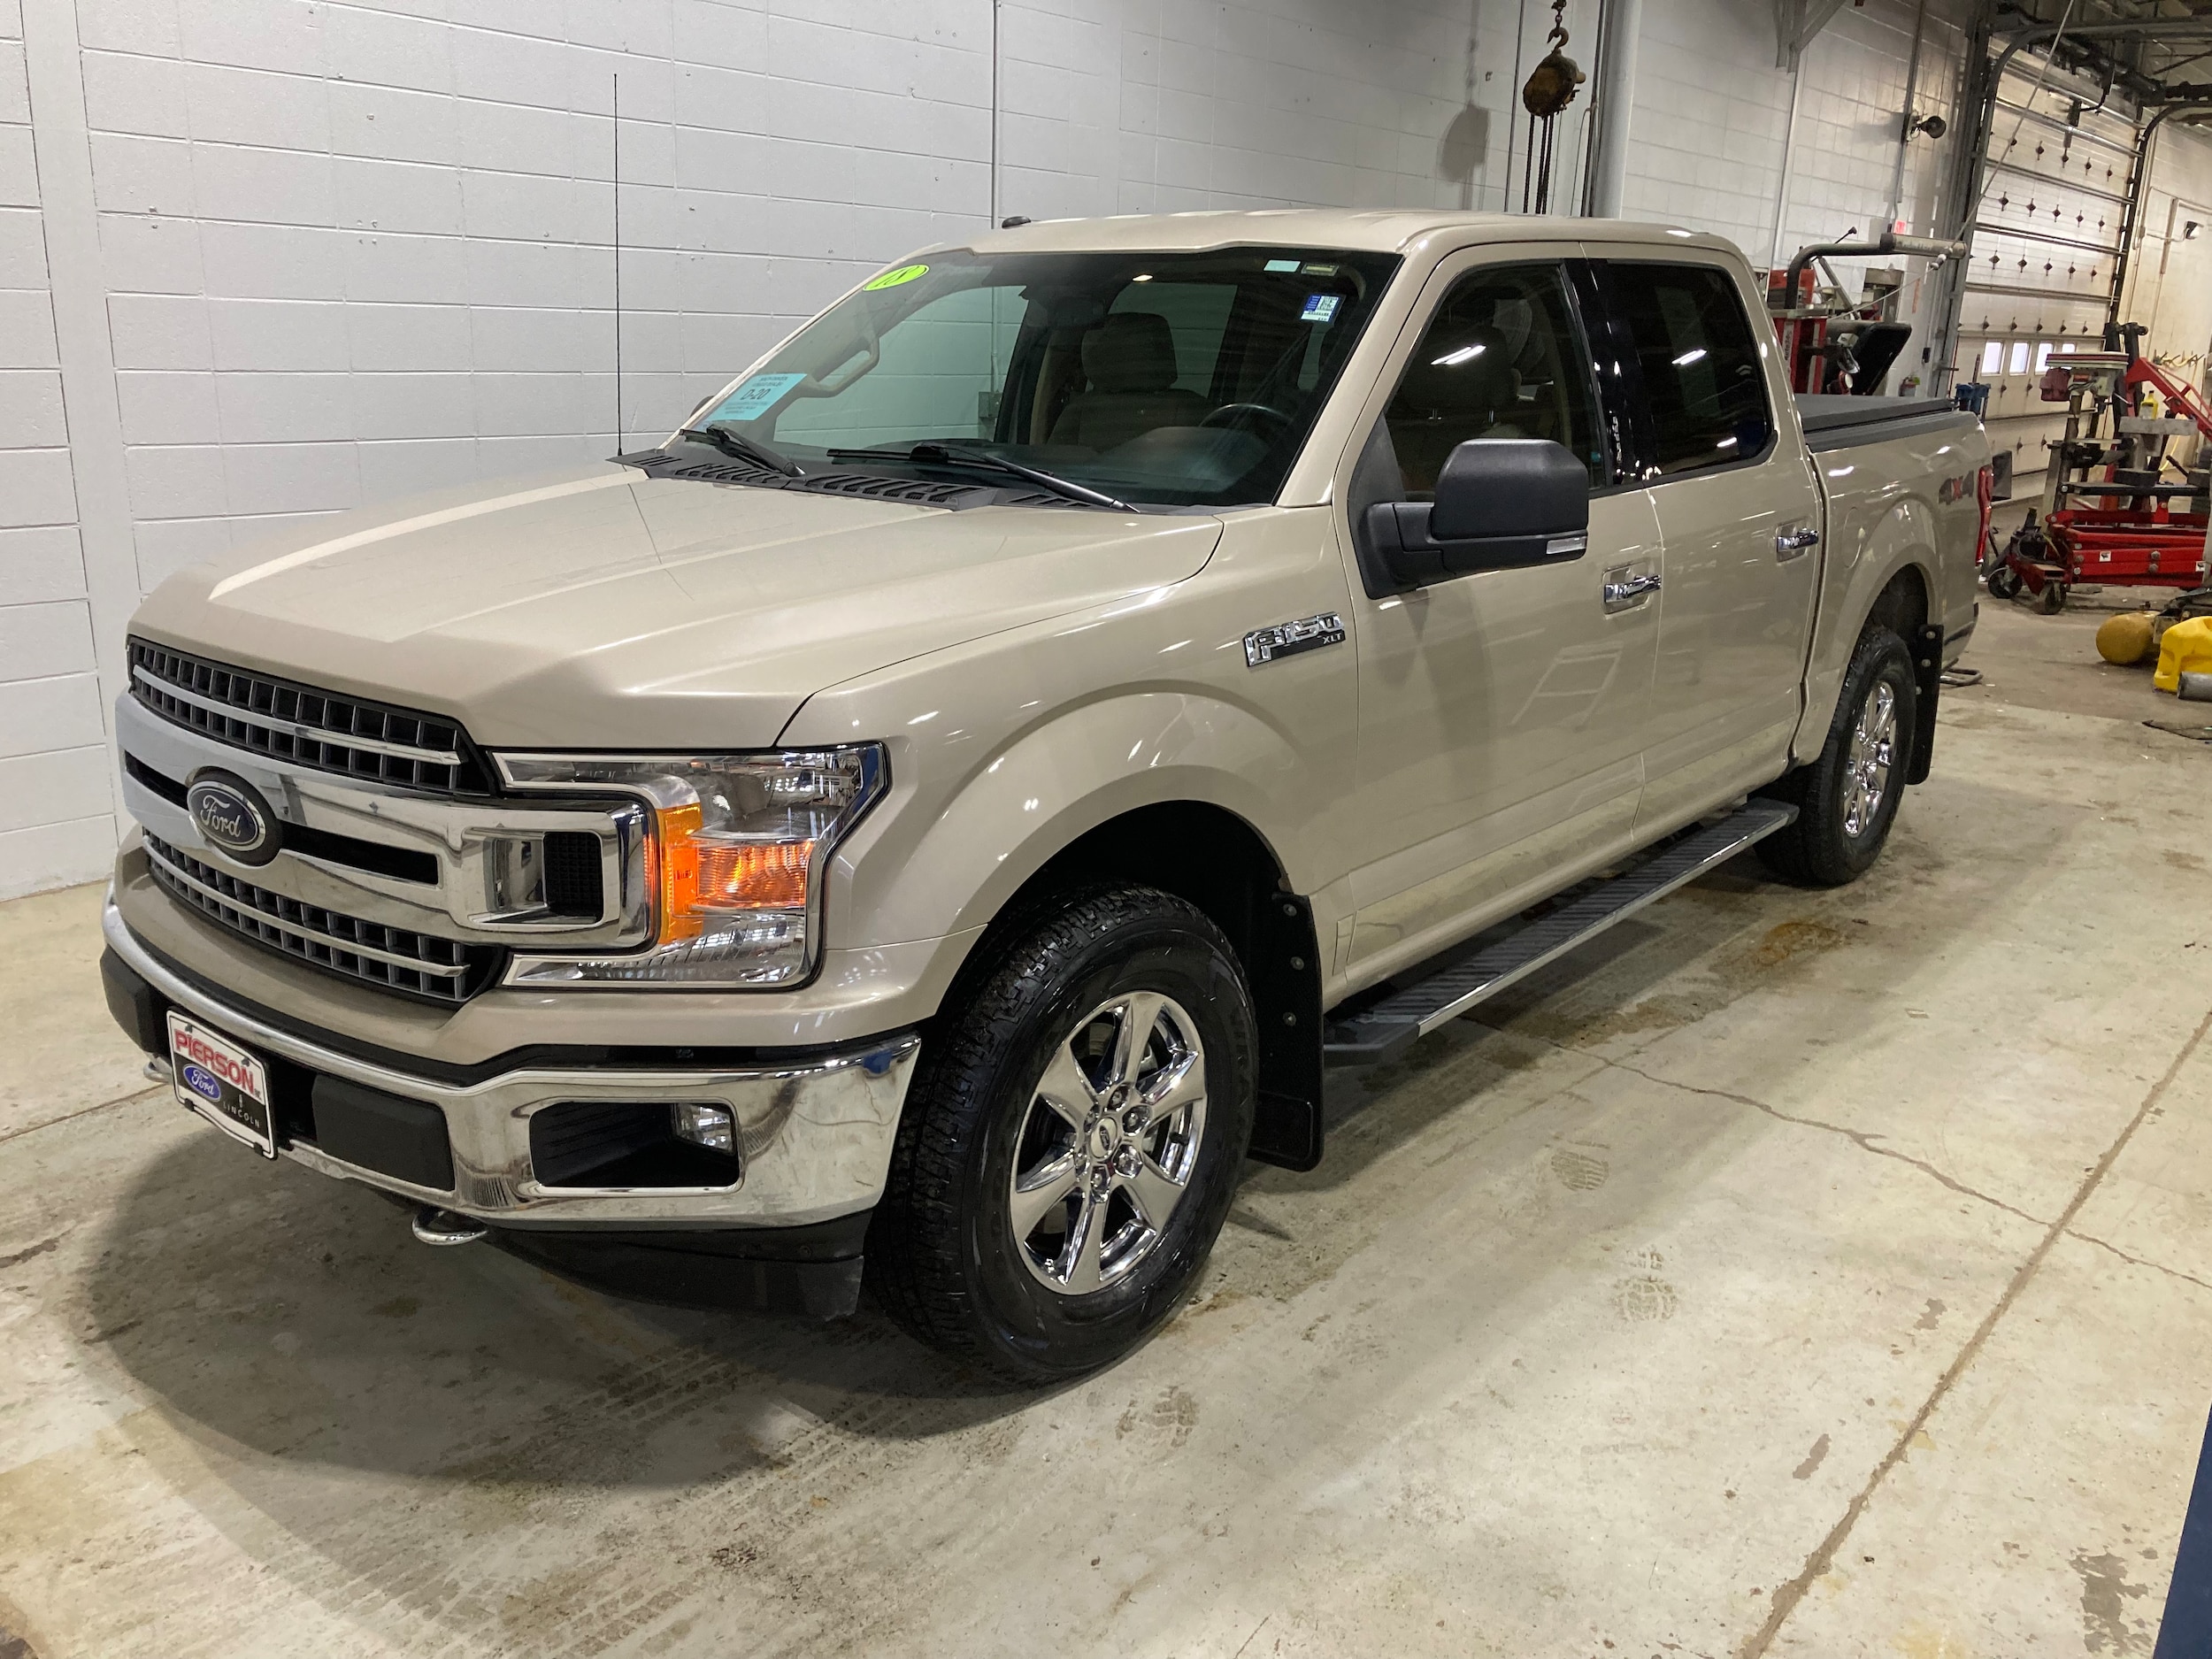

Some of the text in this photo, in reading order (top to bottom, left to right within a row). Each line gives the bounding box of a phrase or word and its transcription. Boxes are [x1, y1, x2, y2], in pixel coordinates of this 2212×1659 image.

[1323, 634, 1342, 645] XLT
[200, 795, 241, 837] Ford
[174, 1029, 255, 1094] PIERSON
[191, 1069, 214, 1095] Ford
[223, 1102, 260, 1129] LINCOLN
